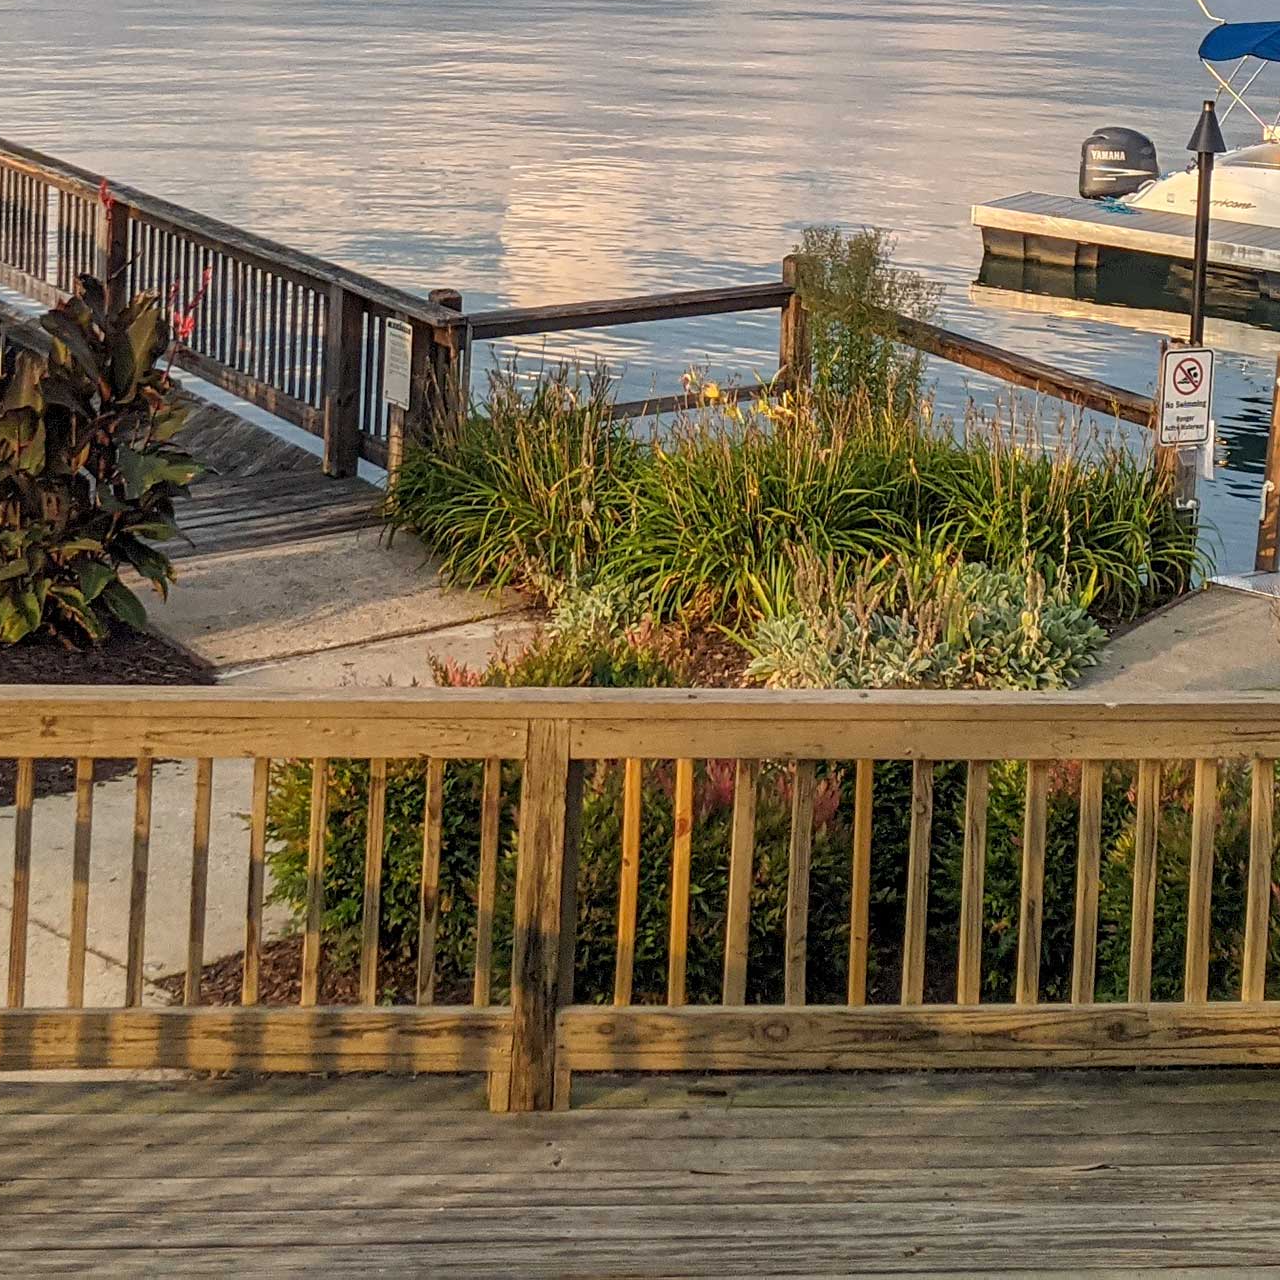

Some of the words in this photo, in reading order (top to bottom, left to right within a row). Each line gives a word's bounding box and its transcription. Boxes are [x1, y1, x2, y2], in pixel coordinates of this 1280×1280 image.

[1091, 150, 1126, 161] YAMAHA
[1165, 401, 1174, 409] No
[1175, 399, 1207, 409] Swimming
